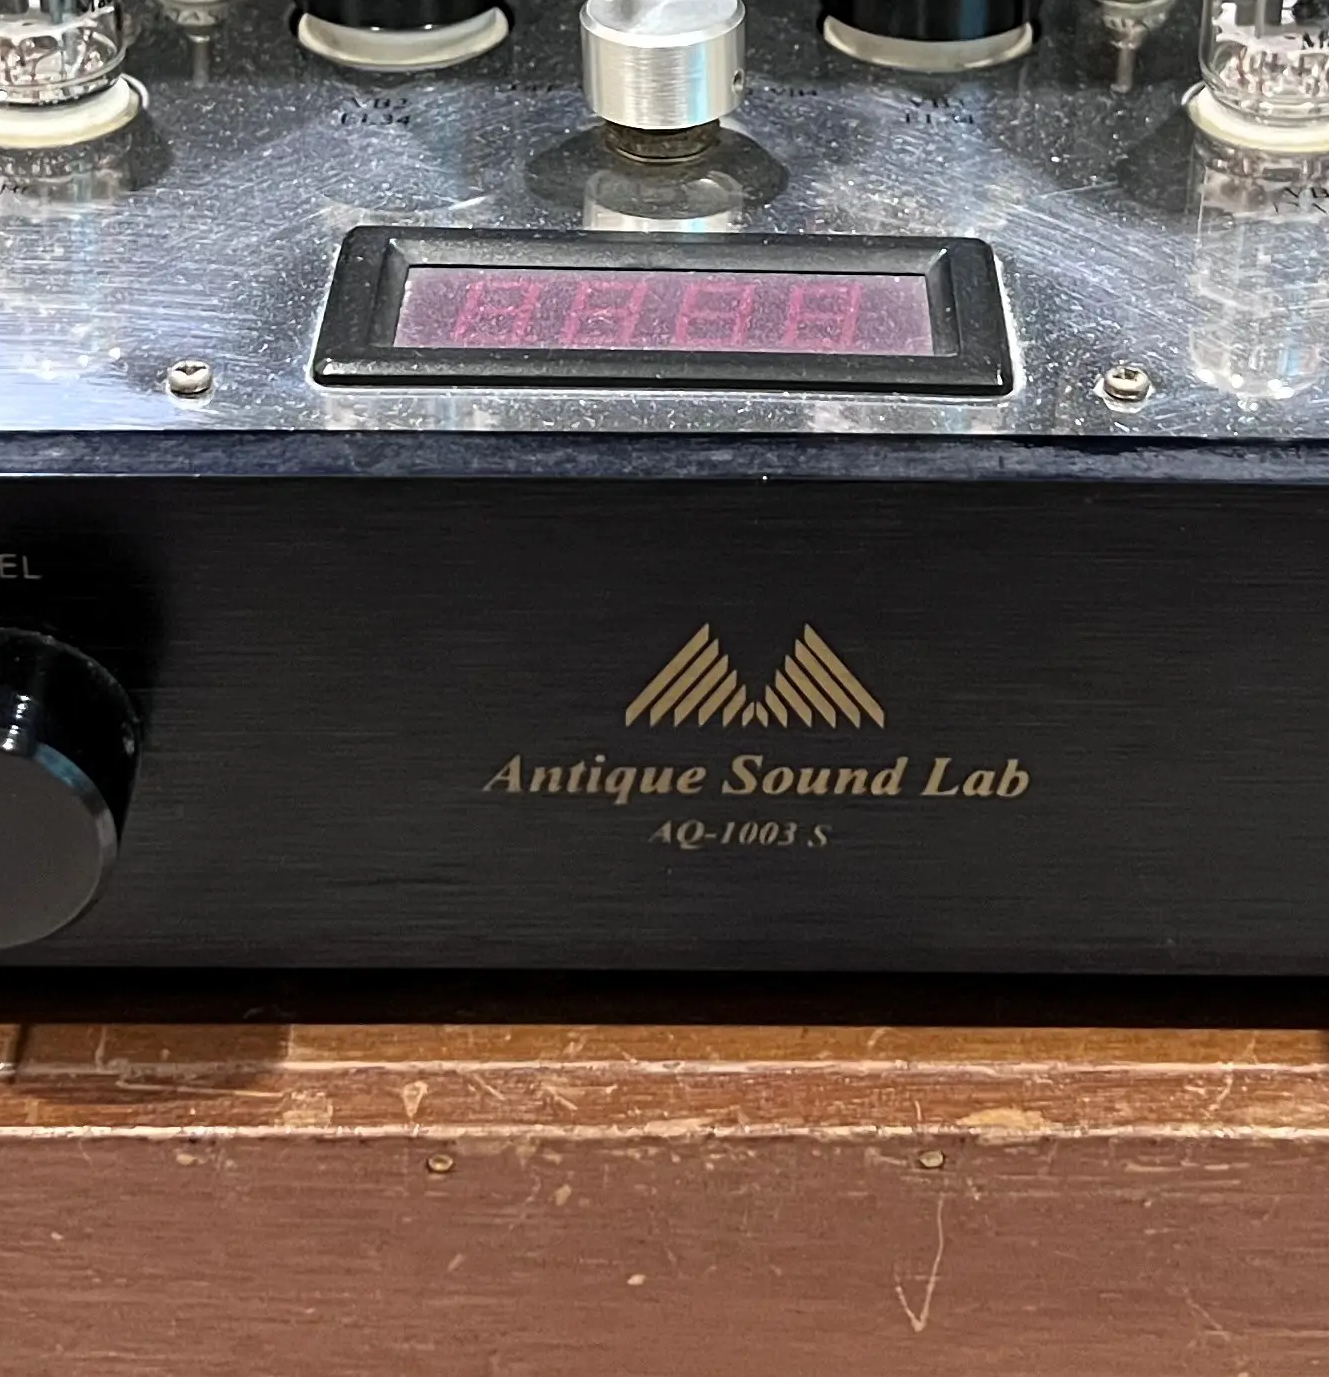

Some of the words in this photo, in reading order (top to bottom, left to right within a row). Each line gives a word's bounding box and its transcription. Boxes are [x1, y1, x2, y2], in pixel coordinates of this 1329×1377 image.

[482, 754, 707, 805] Antique
[721, 754, 909, 796] Sound
[920, 757, 1031, 798] Lab
[648, 821, 797, 850] AQ-1003
[807, 823, 831, 847] S
